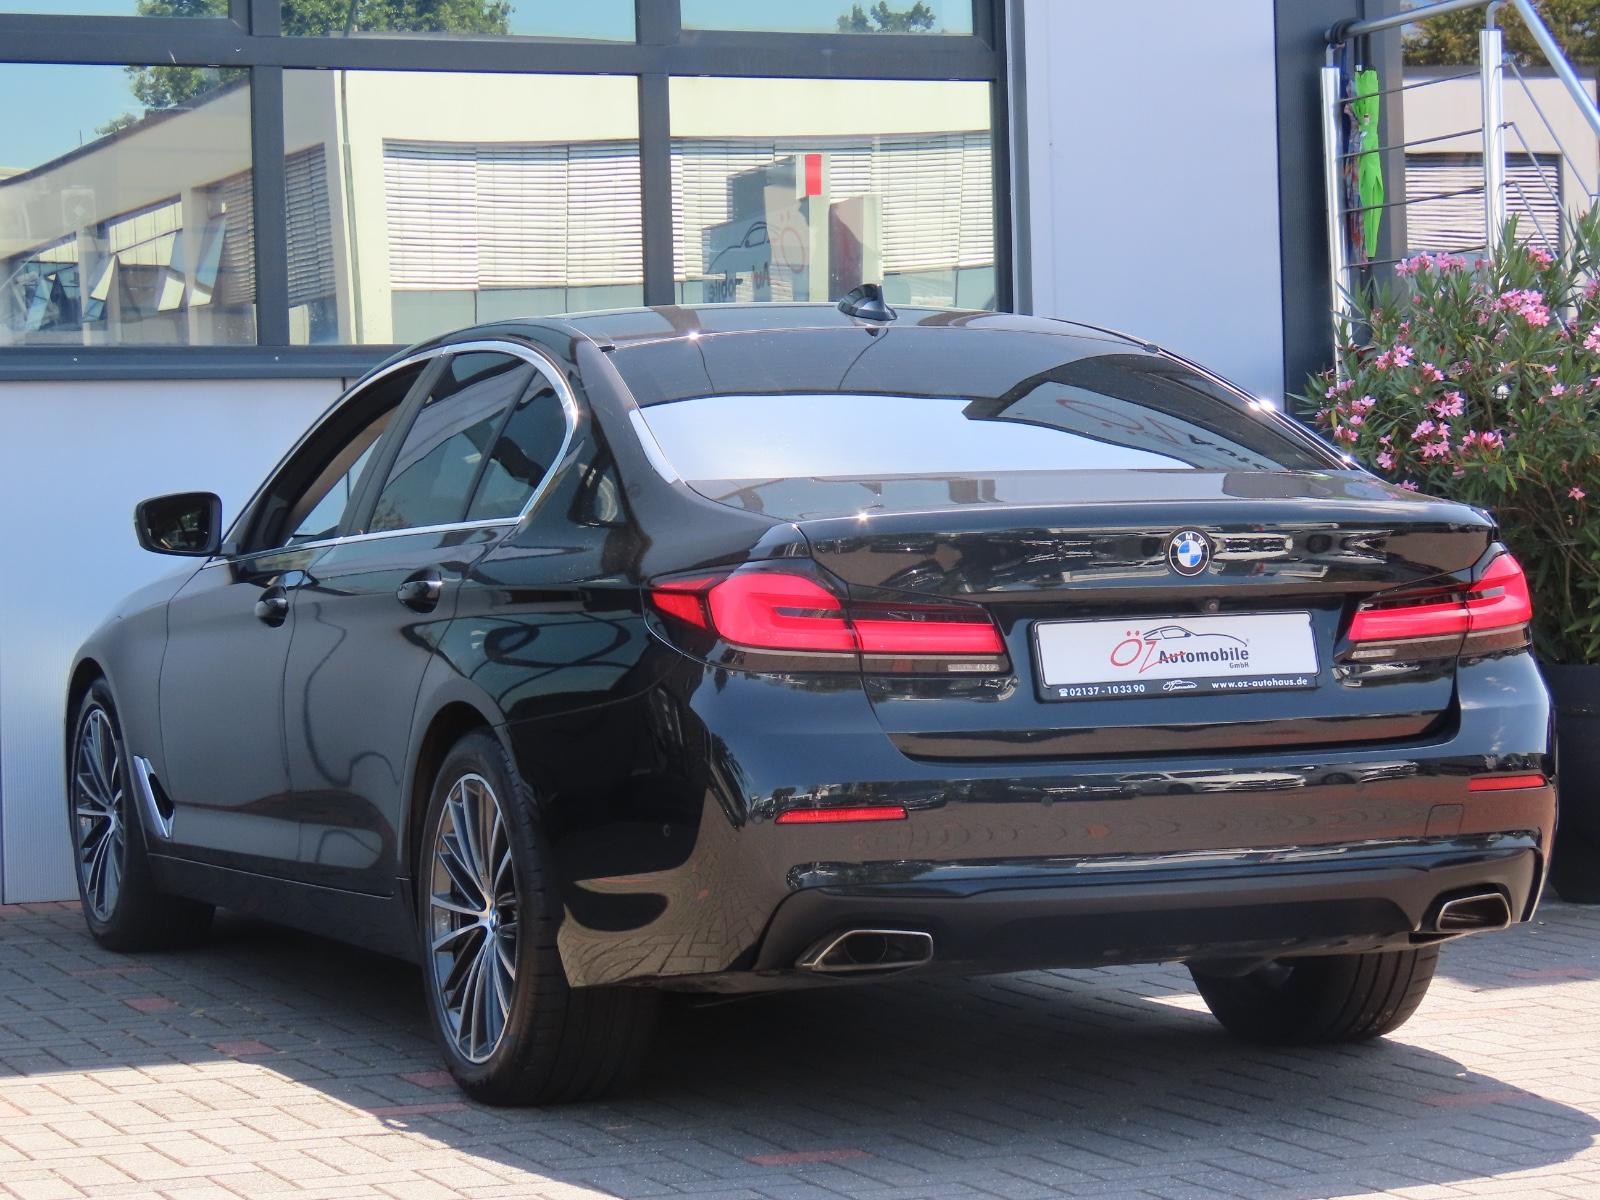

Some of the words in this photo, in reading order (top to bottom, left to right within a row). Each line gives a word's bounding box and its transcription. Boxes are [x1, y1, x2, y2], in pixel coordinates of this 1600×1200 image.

[1173, 532, 1206, 548] BMW
[1159, 647, 1249, 664] Automobile
[1211, 677, 1308, 689] www.oz-autohaus.de
[1069, 686, 1100, 697] 02137
